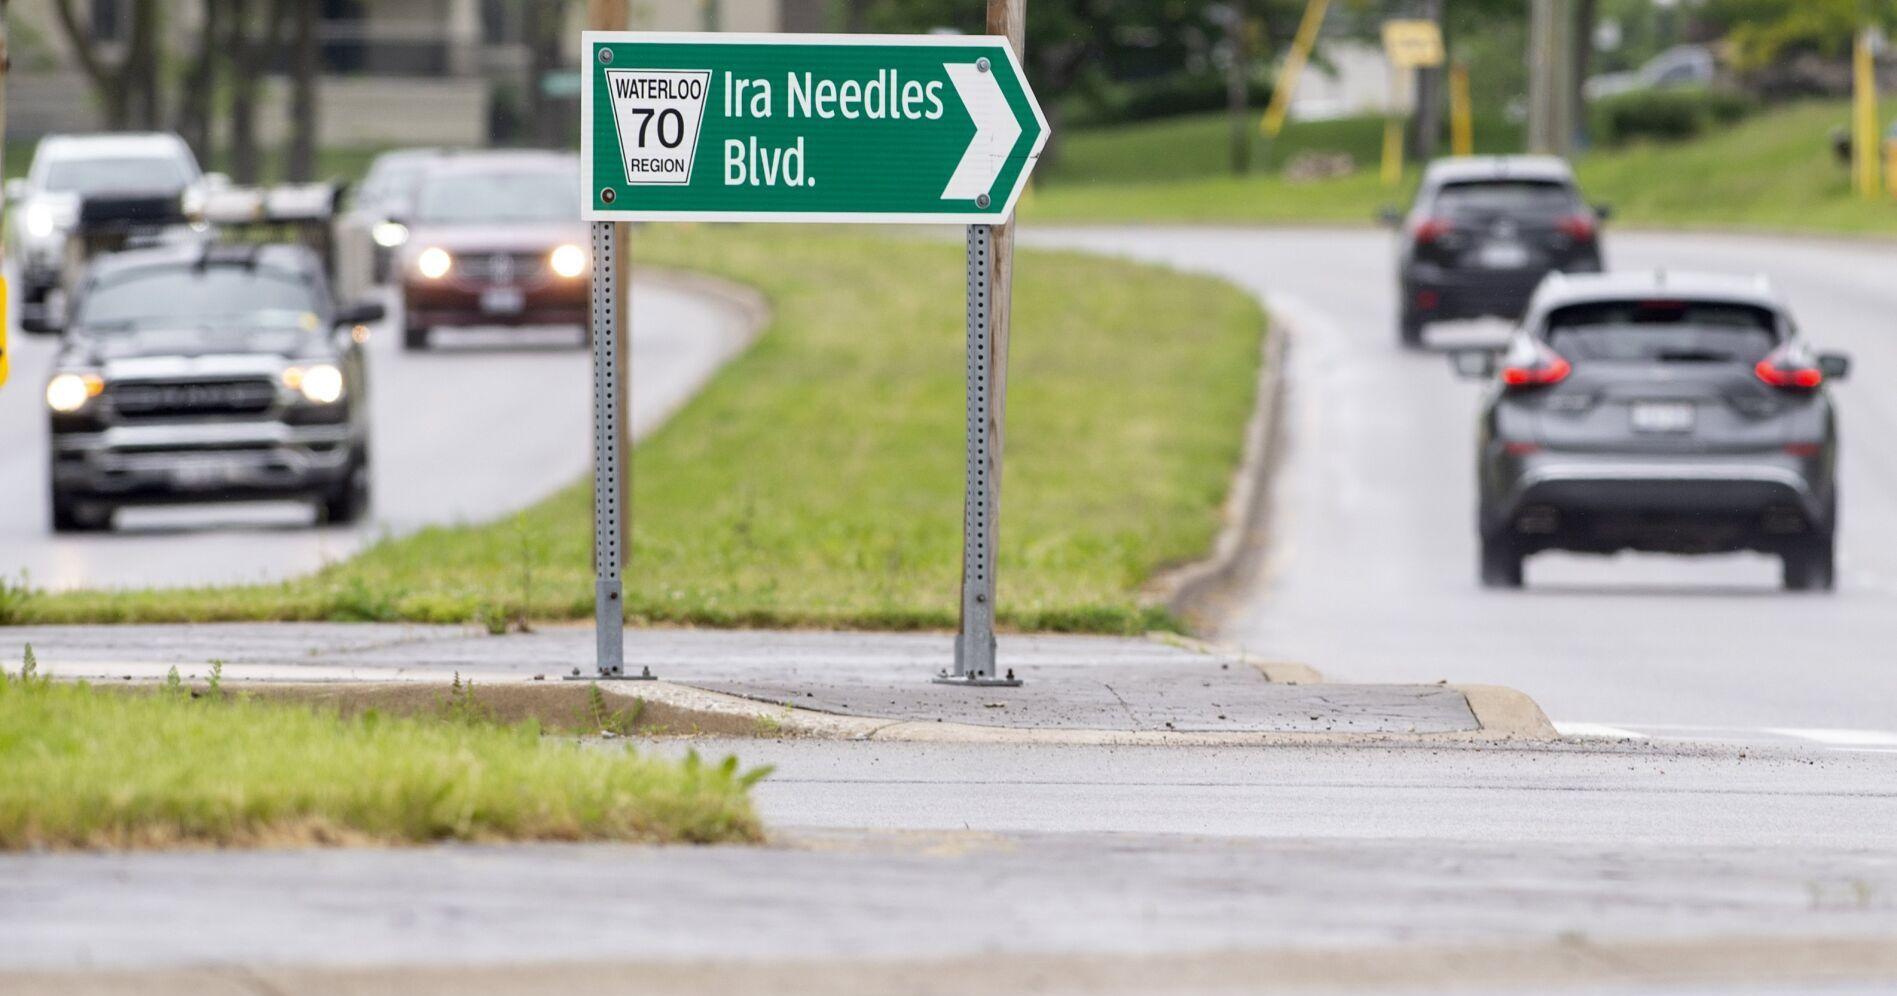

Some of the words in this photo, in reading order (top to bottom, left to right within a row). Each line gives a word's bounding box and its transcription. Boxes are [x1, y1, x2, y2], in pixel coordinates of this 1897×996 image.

[615, 78, 702, 101] WATERLOO
[724, 70, 772, 118] Ira
[787, 68, 944, 120] Needles
[631, 107, 685, 149] 70
[631, 157, 685, 173] REGION
[724, 135, 816, 187] Blvd.
